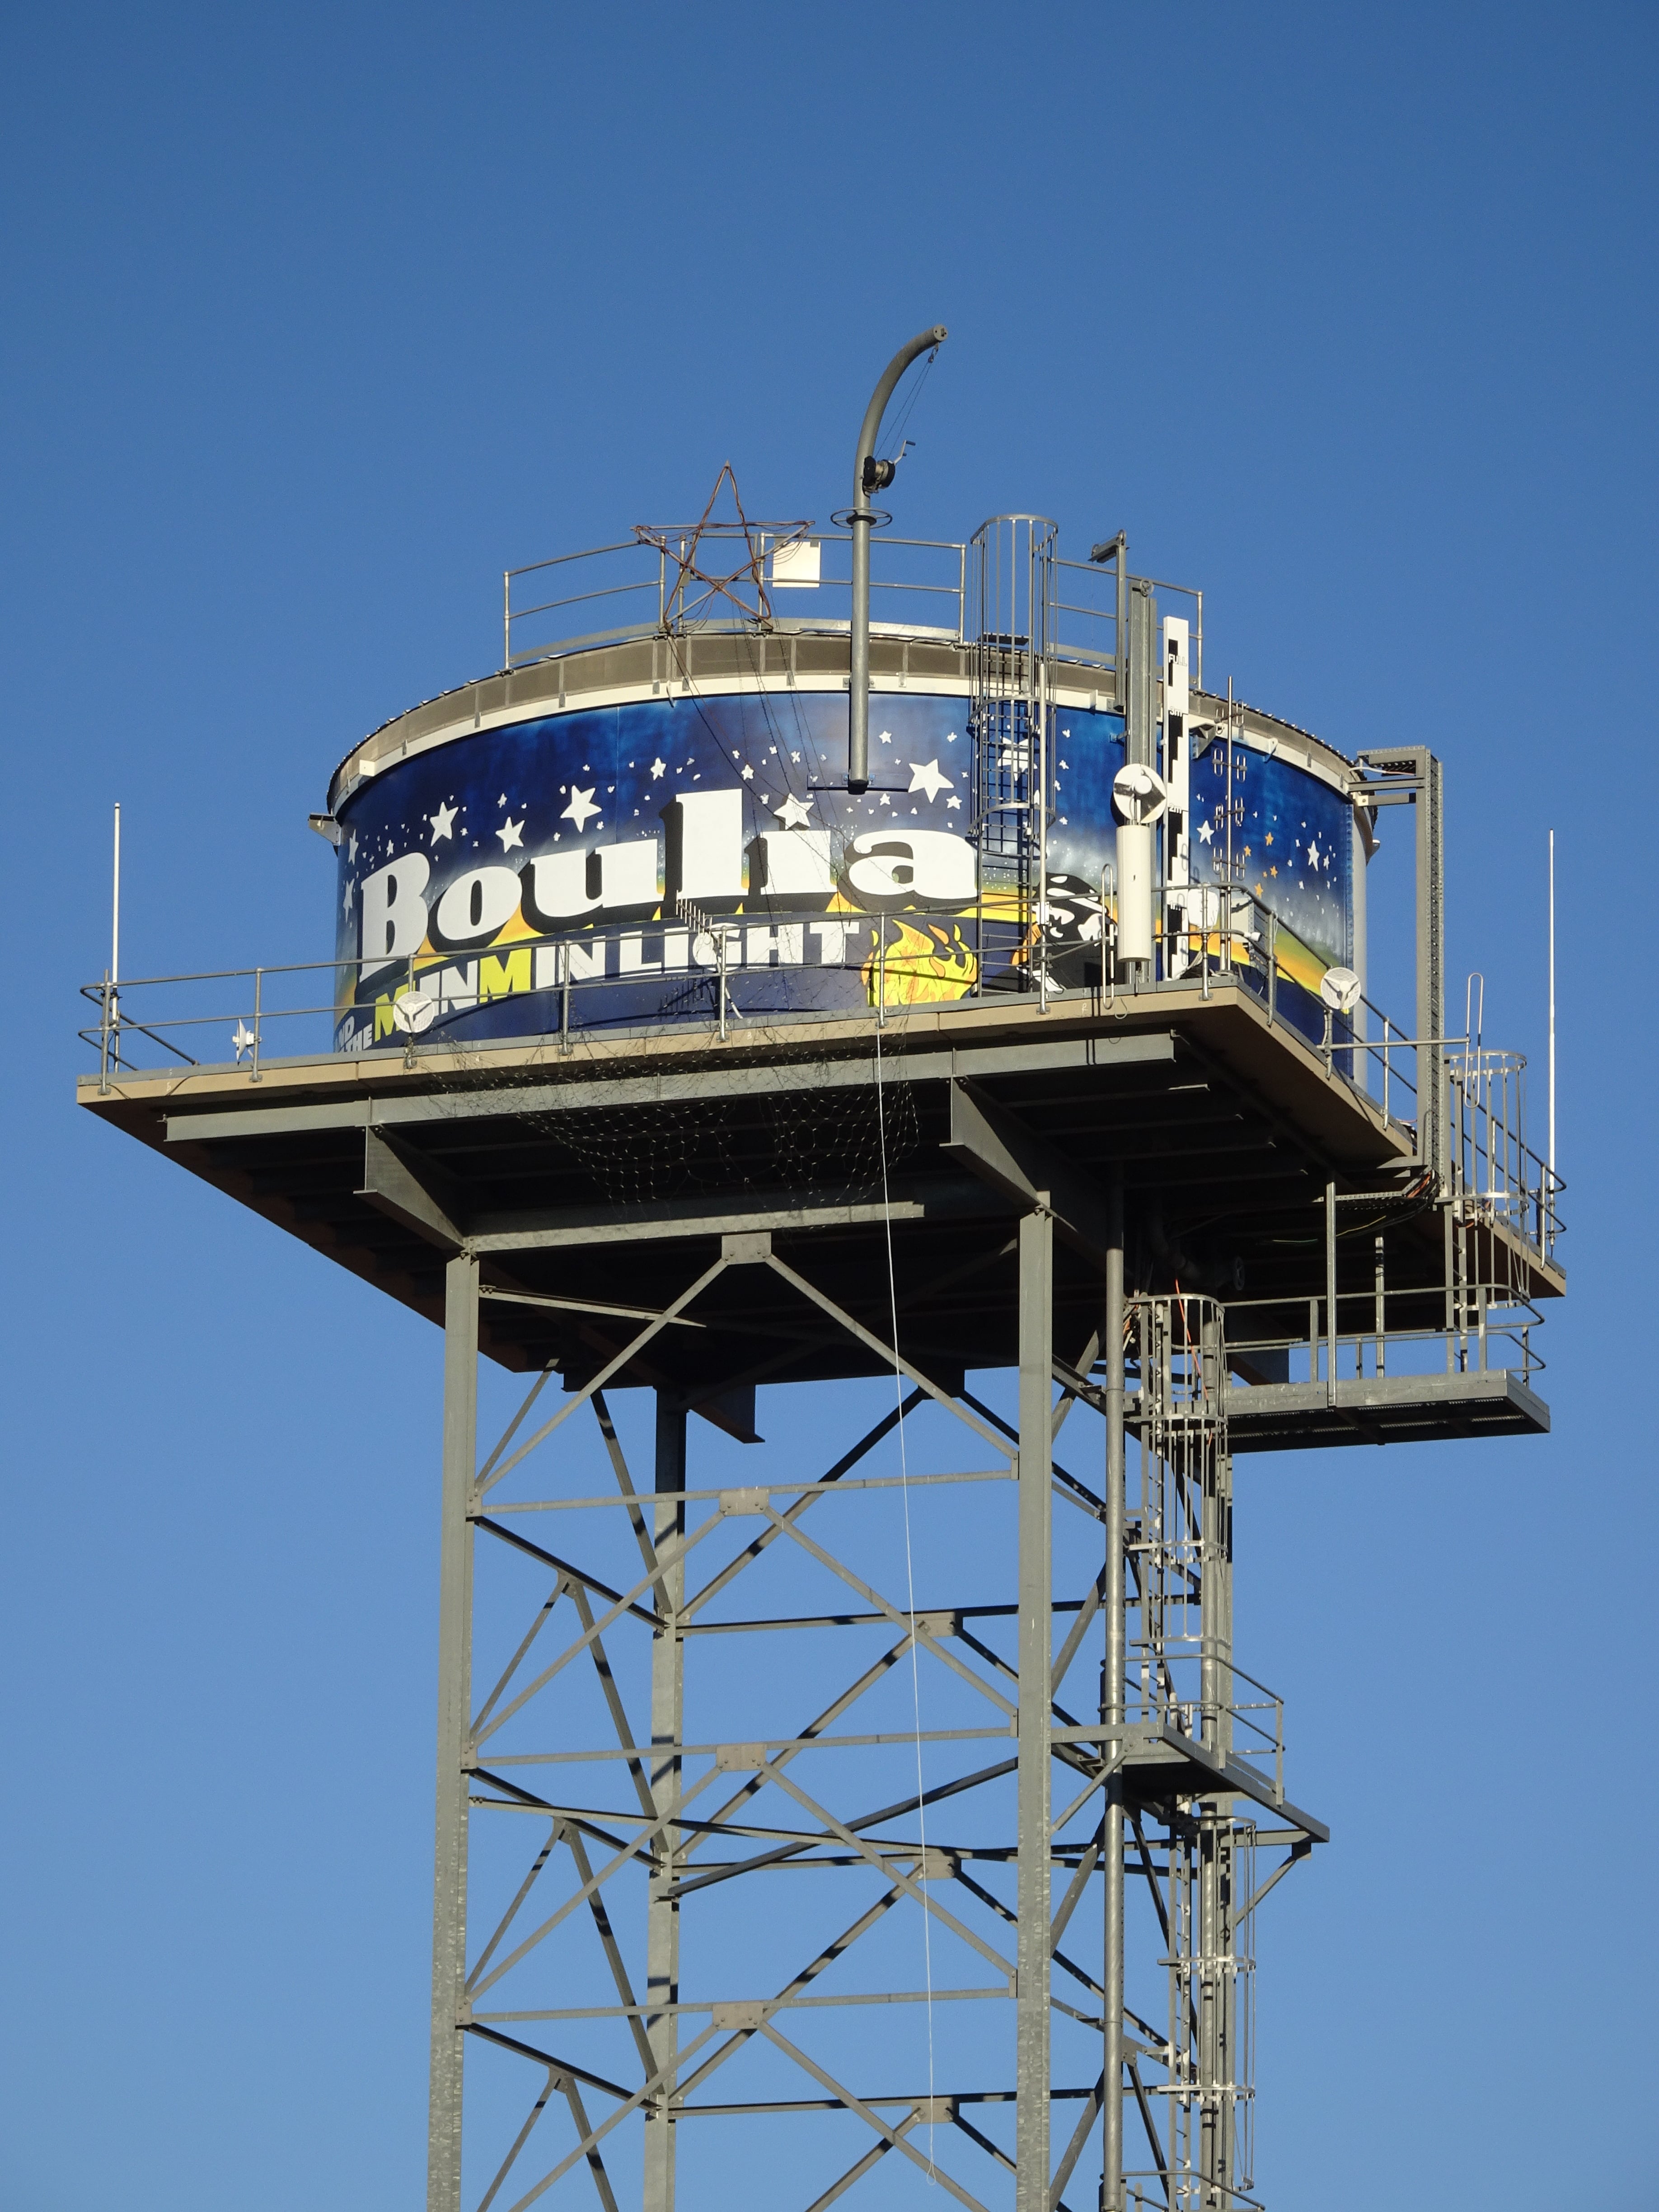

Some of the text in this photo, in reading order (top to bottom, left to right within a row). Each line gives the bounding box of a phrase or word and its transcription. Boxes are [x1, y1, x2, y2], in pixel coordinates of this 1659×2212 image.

[1168, 653, 1187, 666] FULL
[1169, 803, 1182, 814] 2m
[360, 789, 979, 982] Boulia
[620, 922, 859, 977] LIGHT
[345, 1023, 373, 1052] THE
